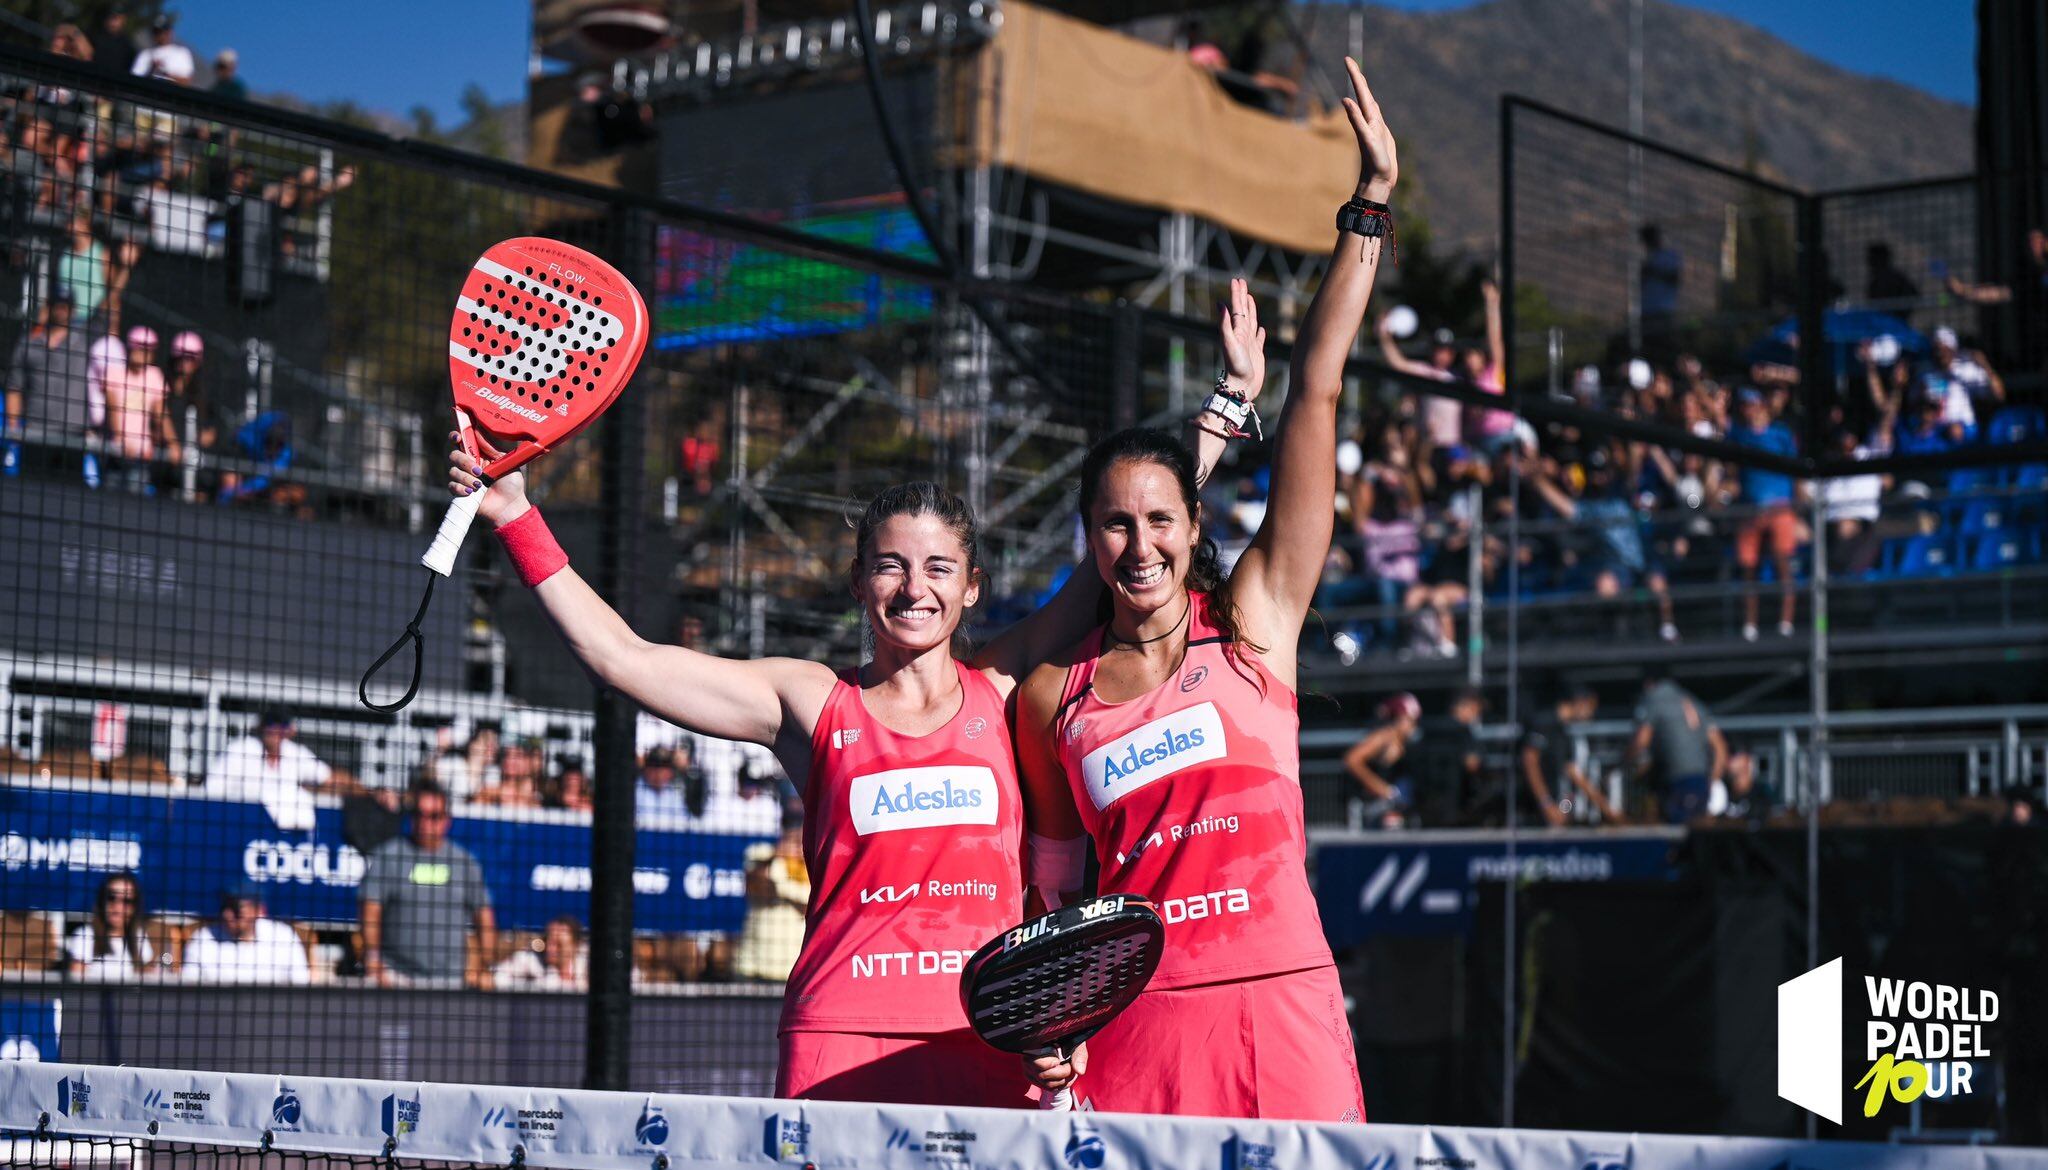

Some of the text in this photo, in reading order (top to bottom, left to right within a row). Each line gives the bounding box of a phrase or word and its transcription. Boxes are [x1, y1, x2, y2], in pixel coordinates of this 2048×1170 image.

[548, 262, 586, 285] FLOW
[474, 386, 549, 424] Bullpadel
[1103, 728, 1205, 788] Adeslas
[871, 779, 982, 816] Adeslas
[1170, 815, 1239, 842] Renting
[928, 879, 998, 901] Renting
[1003, 896, 1125, 953] Buldel
[851, 950, 978, 978] NTT DA
[71, 1080, 91, 1094] WORLD
[72, 1091, 90, 1103] PADEL
[173, 1090, 211, 1101] mercados
[173, 1102, 185, 1111] en
[397, 1098, 421, 1113] WORLD
[397, 1111, 419, 1123] PADEL
[517, 1108, 564, 1120] mercados
[518, 1120, 530, 1129] en
[925, 1130, 977, 1142] mercados
[924, 1143, 938, 1152] en
